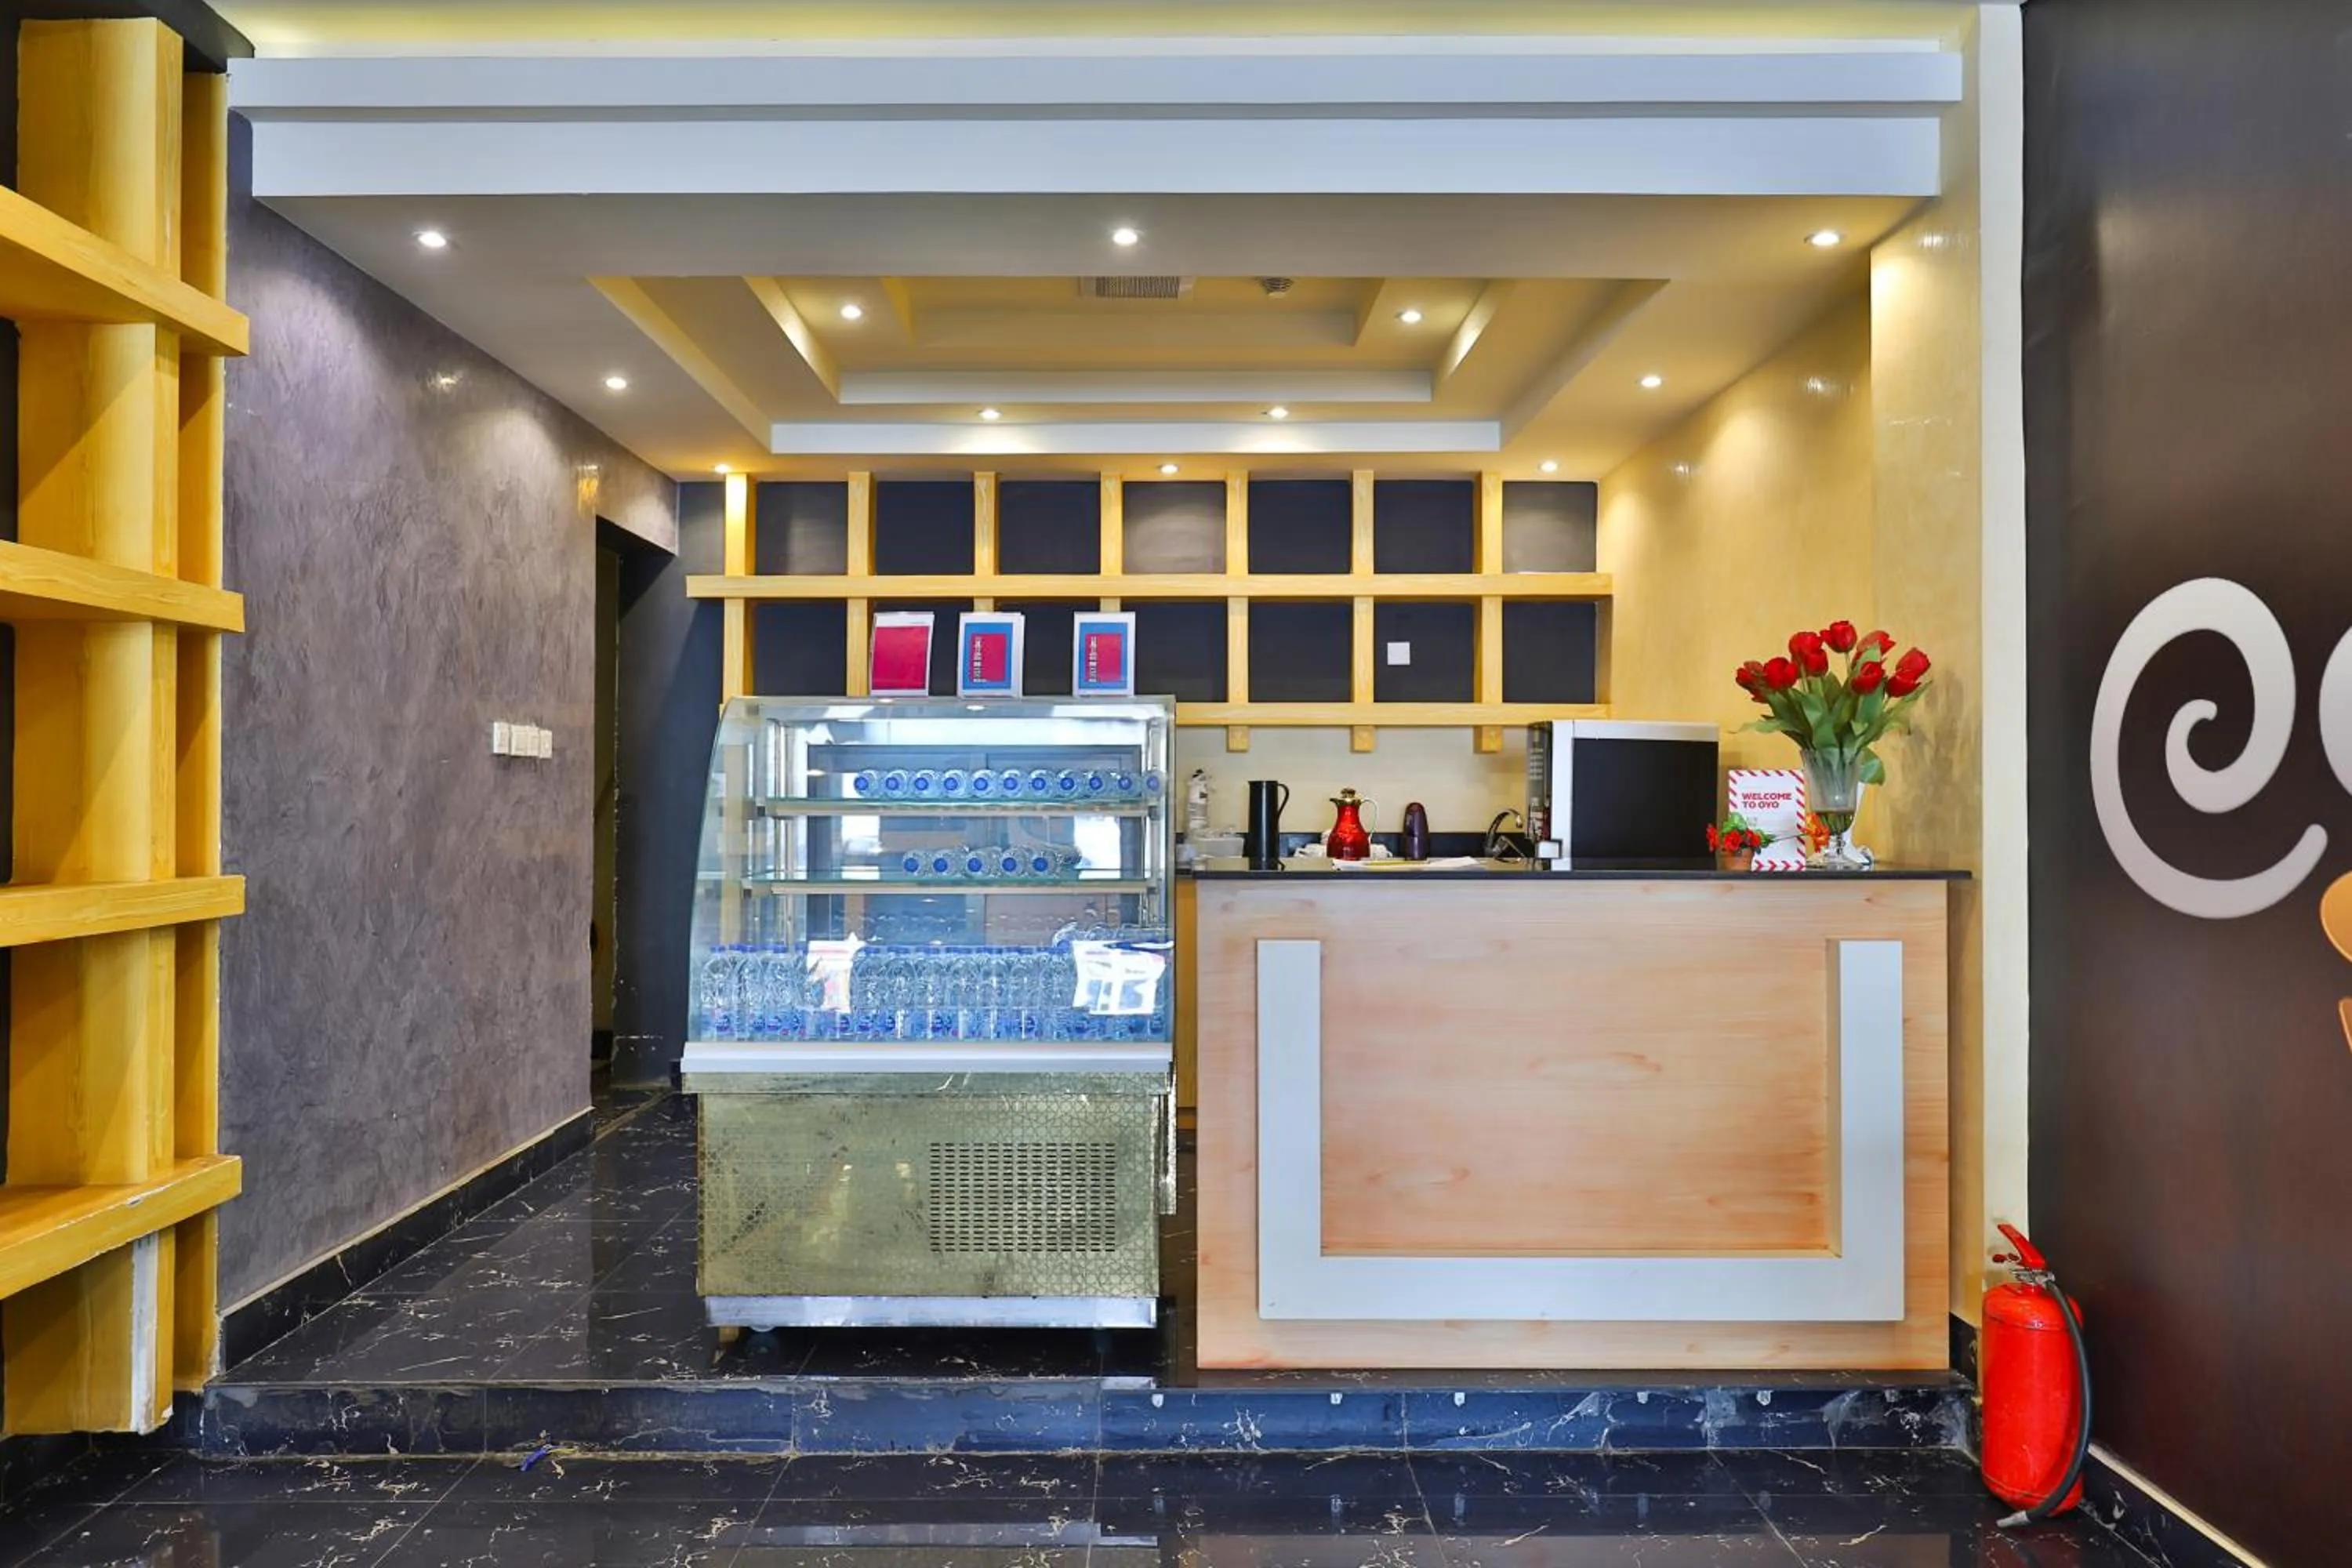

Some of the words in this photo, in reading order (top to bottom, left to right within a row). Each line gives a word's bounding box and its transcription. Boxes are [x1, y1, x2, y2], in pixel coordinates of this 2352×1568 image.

[1741, 792, 1792, 800] WELCOME
[1741, 800, 1757, 809] TO
[1758, 800, 1780, 809] OYO
